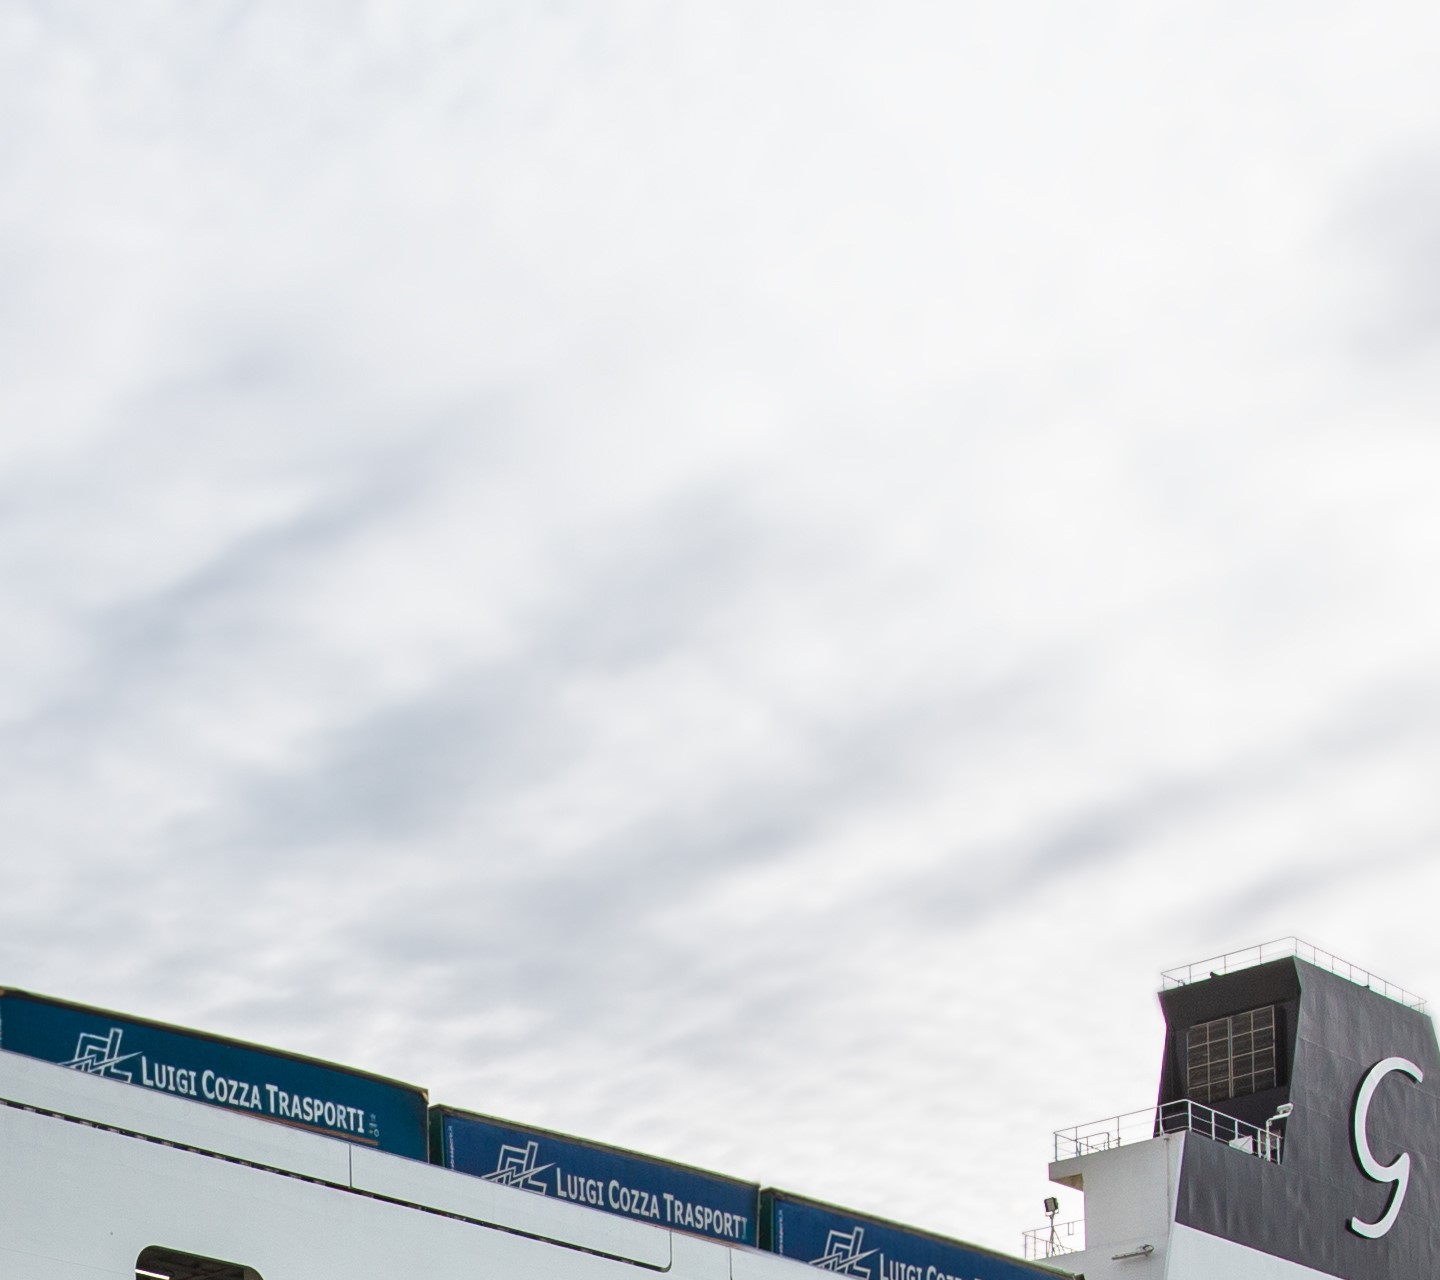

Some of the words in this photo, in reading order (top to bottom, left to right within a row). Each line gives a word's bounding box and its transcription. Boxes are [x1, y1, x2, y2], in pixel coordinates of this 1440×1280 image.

[141, 1055, 197, 1095] LUIGI
[202, 1070, 262, 1110] COZZA
[266, 1084, 364, 1133] TRASPORTI
[556, 1167, 604, 1206] LUIGI
[608, 1180, 660, 1219] COZZA
[663, 1193, 748, 1240] TRASPORTI
